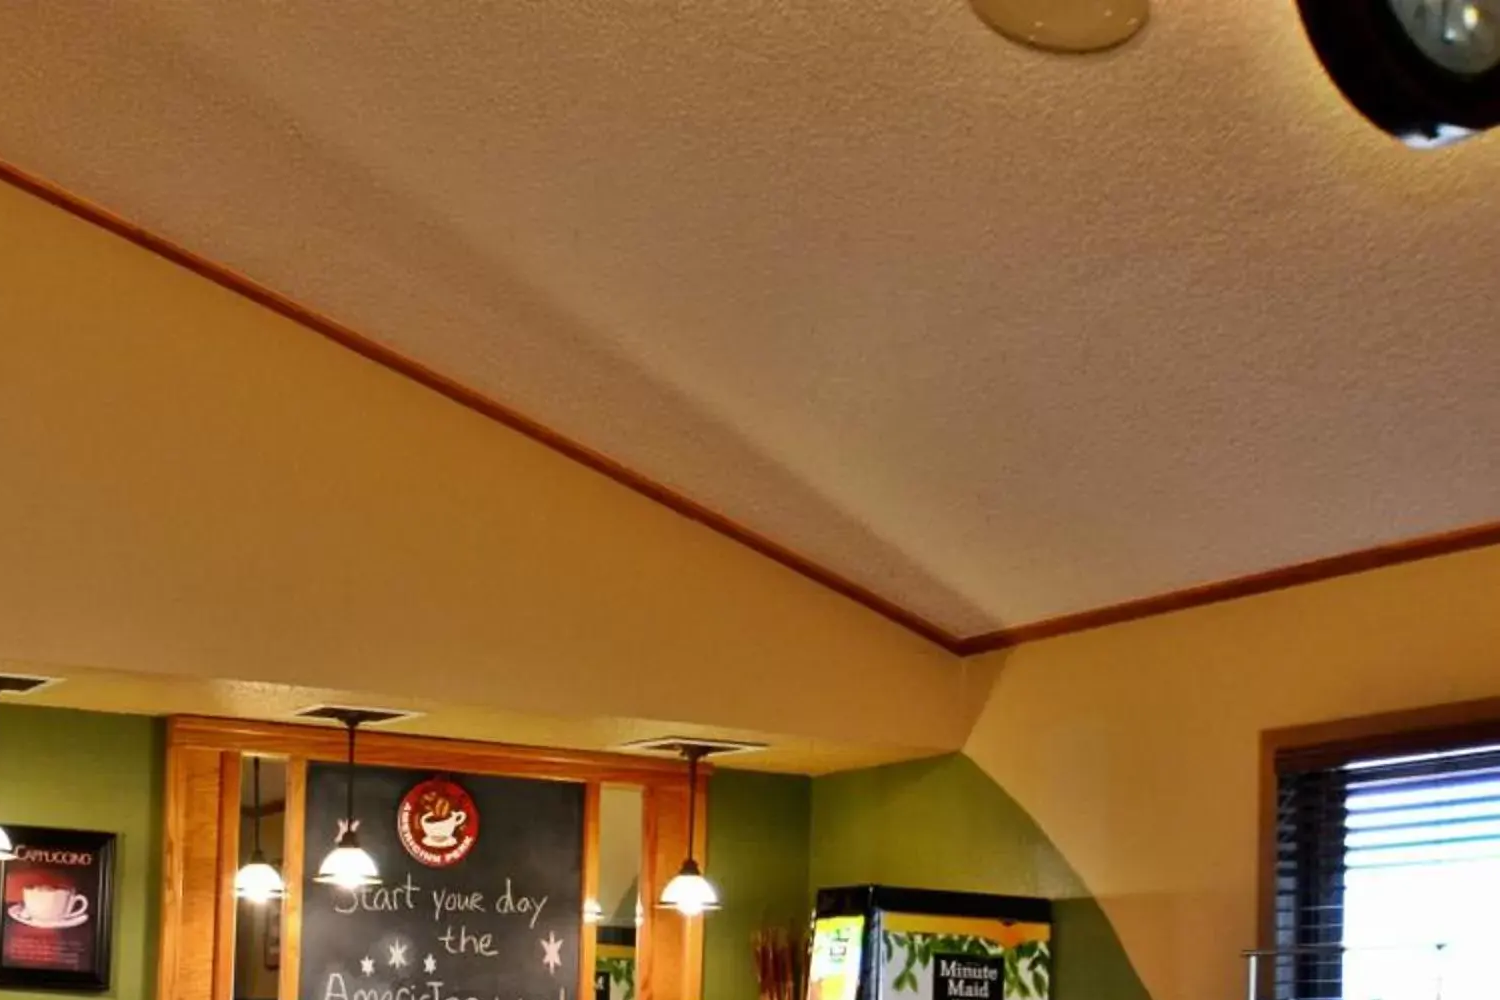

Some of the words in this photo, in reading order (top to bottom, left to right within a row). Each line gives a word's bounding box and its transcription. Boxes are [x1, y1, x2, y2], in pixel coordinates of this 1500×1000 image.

[495, 877, 548, 929] day
[438, 925, 499, 956] the
[940, 959, 998, 981] Minute
[947, 978, 990, 998] Maid
